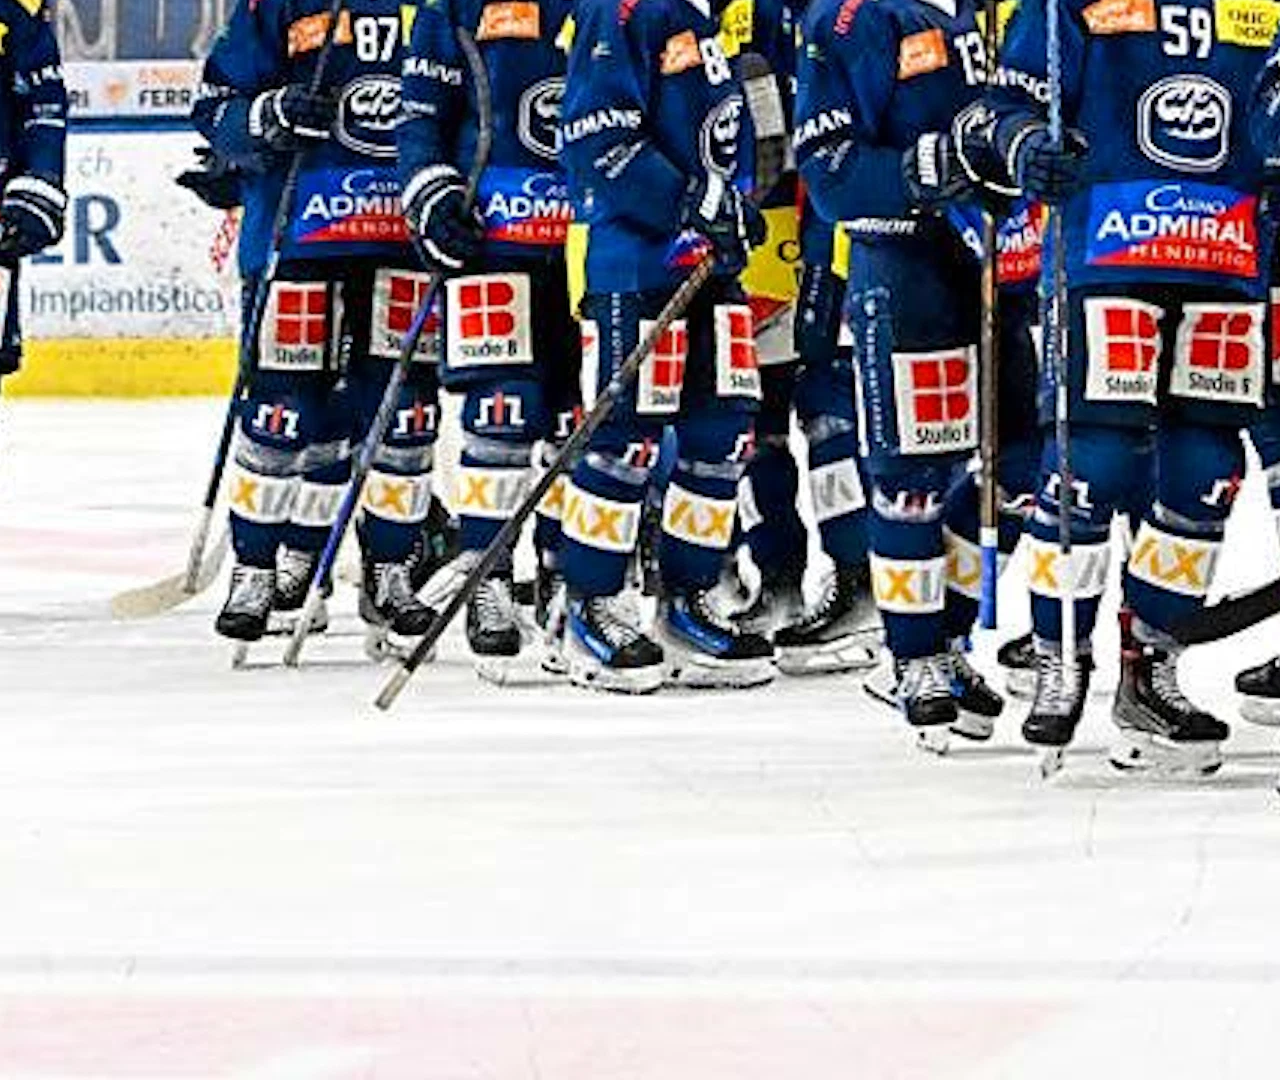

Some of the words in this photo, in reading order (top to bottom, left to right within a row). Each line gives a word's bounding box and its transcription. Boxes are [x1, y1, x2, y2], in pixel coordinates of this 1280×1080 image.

[354, 17, 399, 62] 87
[1159, 4, 1212, 58] 59
[138, 90, 192, 109] FERR
[1096, 210, 1253, 251] ADMIRAL
[30, 281, 224, 320] Impiantistica
